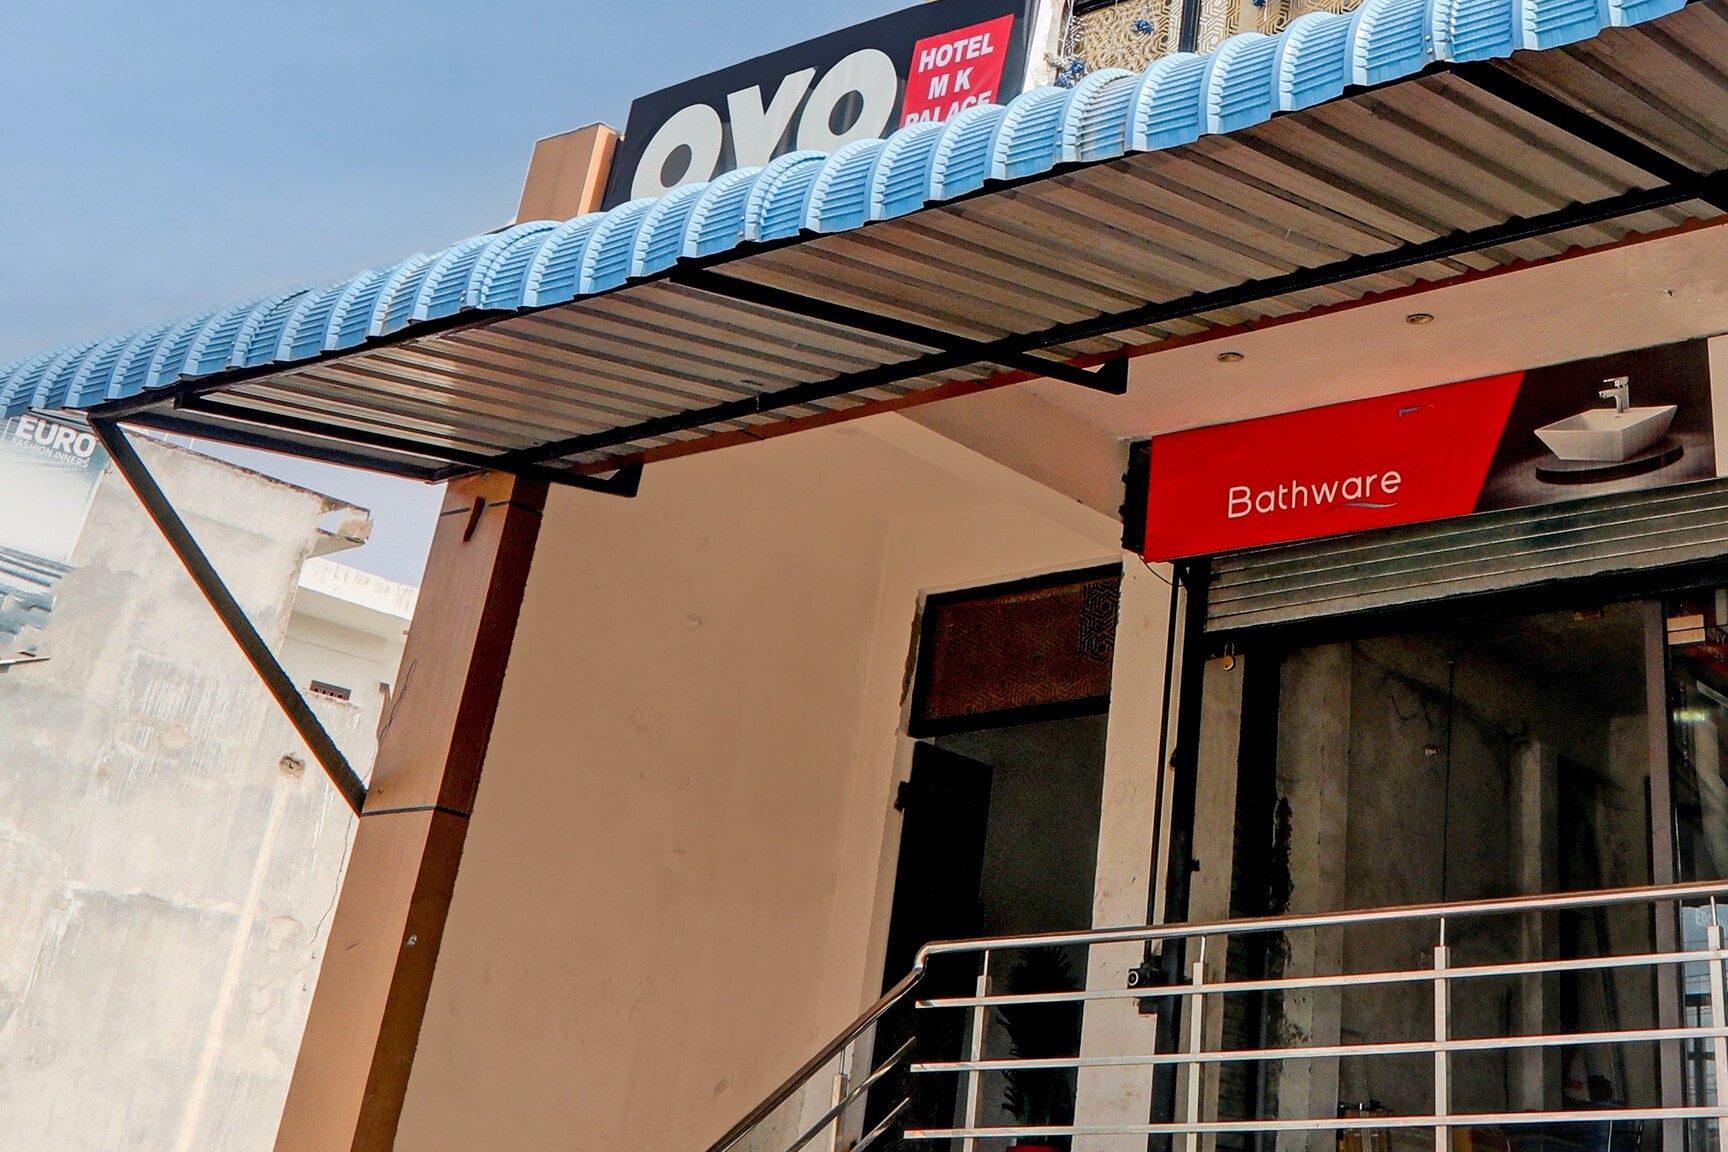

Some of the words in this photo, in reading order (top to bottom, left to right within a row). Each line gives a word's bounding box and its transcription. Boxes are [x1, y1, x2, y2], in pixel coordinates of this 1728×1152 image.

[918, 33, 994, 73] HOTEL
[928, 74, 950, 100] M
[953, 66, 974, 93] K
[631, 48, 897, 200] OYO
[11, 437, 54, 457] FASHION
[54, 451, 90, 468] INNERS
[15, 414, 97, 458] EURO
[1228, 470, 1402, 519] Bathware
